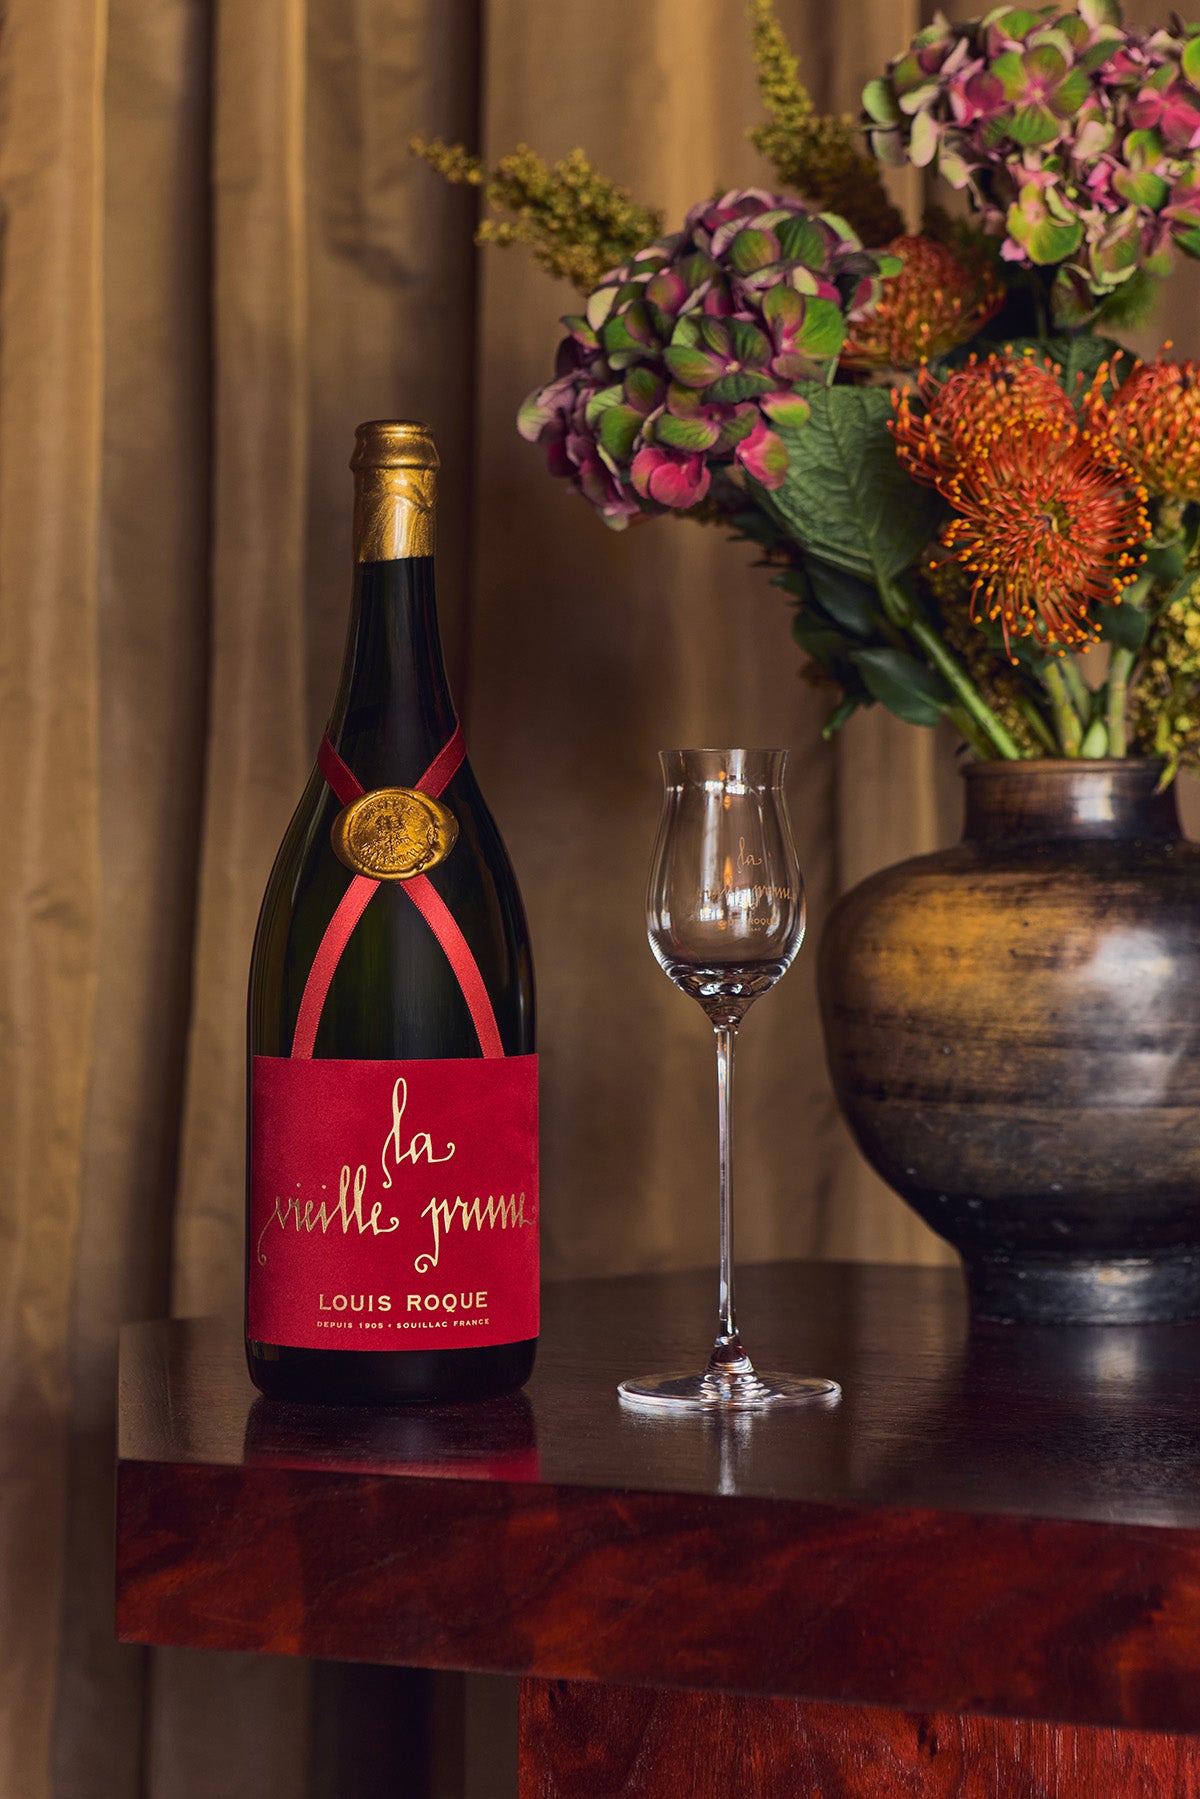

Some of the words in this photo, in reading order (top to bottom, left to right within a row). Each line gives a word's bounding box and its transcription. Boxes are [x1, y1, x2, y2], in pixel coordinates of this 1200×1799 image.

[737, 836, 763, 874] la
[382, 1077, 456, 1189] la
[257, 1165, 400, 1266] vieille
[319, 1294, 392, 1312] LOUIS
[406, 1291, 488, 1313] ROQUE
[317, 1321, 353, 1329] DEPUIS
[396, 1321, 448, 1329] SOUILLAC
[453, 1318, 490, 1326] FRANCE
